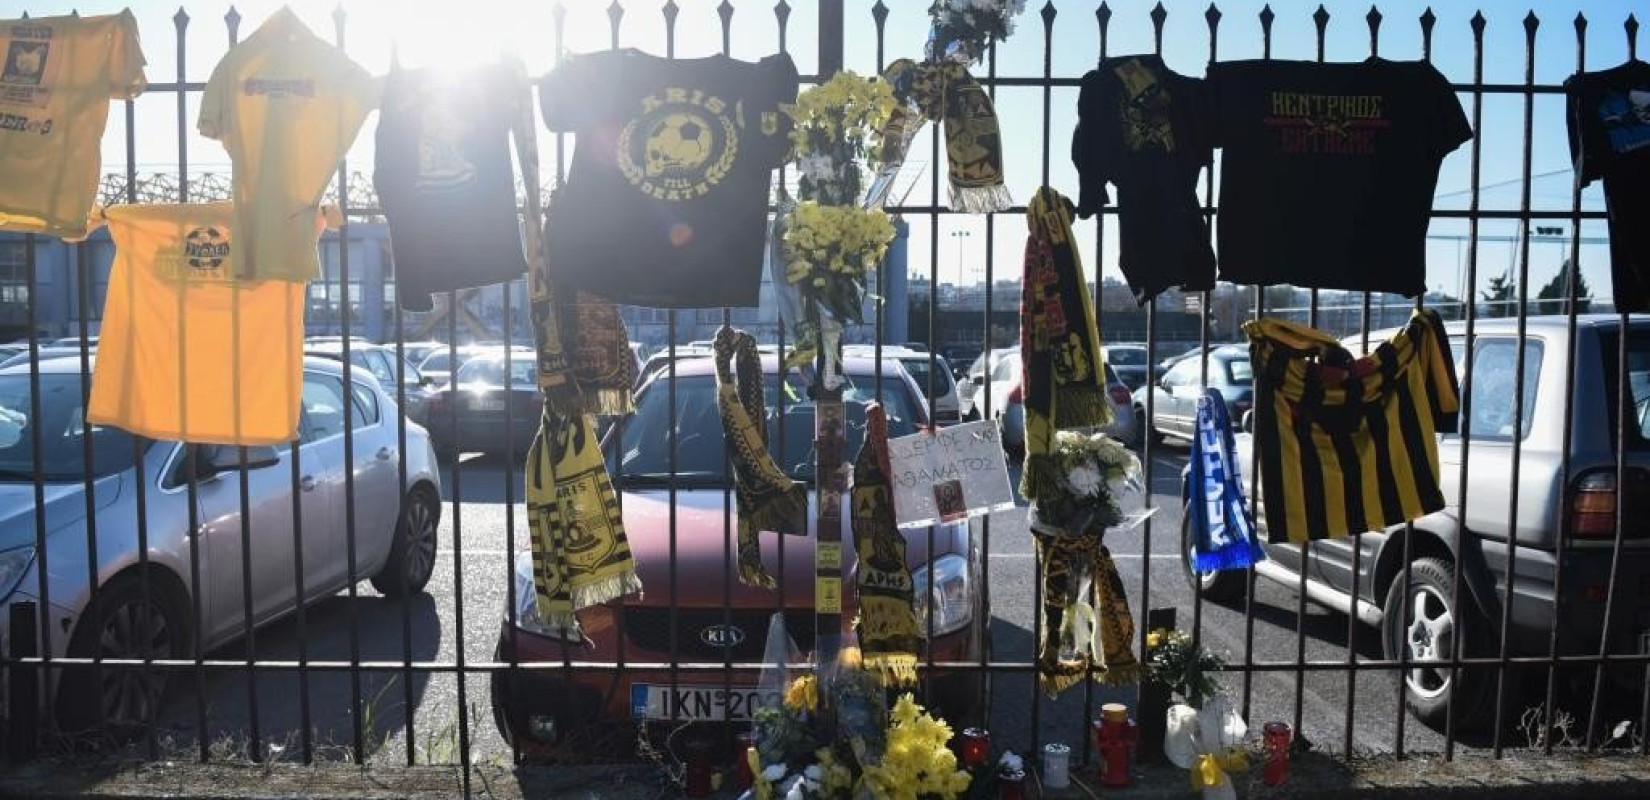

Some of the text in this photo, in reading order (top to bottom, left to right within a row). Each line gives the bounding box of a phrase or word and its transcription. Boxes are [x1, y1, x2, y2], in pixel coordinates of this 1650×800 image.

[642, 87, 725, 115] ARIS
[641, 181, 710, 201] DEATH
[555, 482, 587, 501] ARIS
